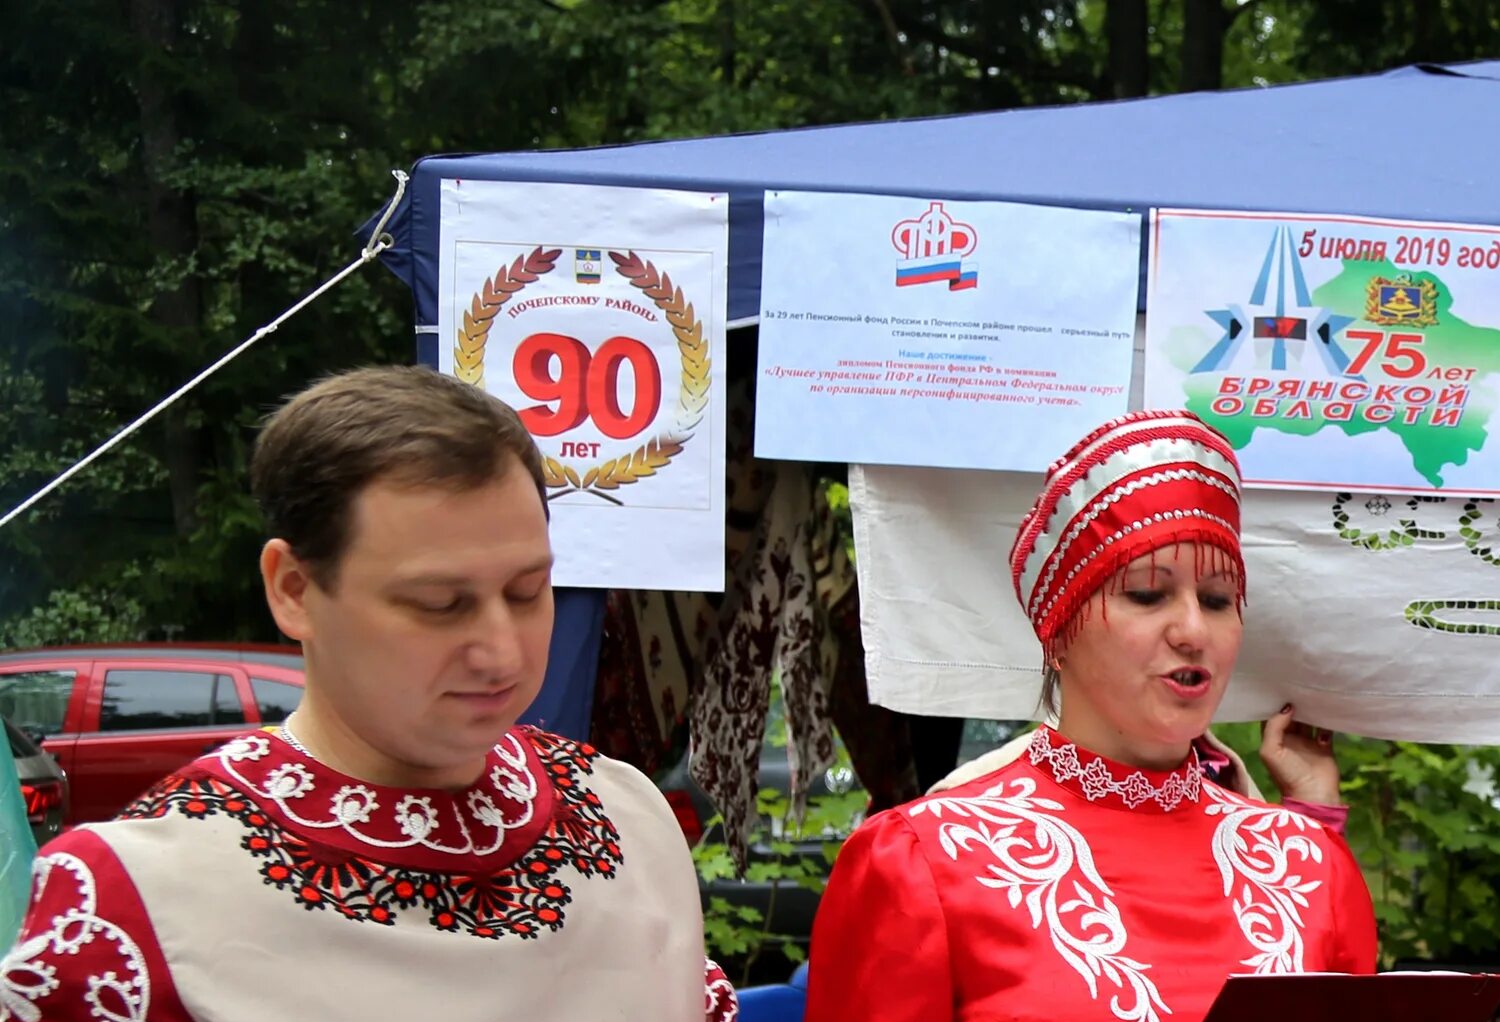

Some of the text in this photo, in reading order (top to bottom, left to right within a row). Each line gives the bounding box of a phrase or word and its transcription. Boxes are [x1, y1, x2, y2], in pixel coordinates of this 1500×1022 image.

[1299, 229, 1316, 258] 5
[1318, 236, 1387, 263] июля
[1395, 235, 1450, 267] 2019
[507, 296, 658, 322] ПОЧЕПСКОМУ РАЙОНУ
[806, 312, 862, 323] Пенсионный
[864, 315, 888, 325] фонд
[891, 317, 921, 326] России
[931, 318, 980, 329] Почепском
[982, 321, 1015, 331] районе
[1017, 324, 1052, 334] прошел
[1061, 327, 1109, 338] серьезный
[892, 329, 947, 340] становления
[837, 359, 882, 368] дипломом
[885, 360, 945, 371] Пенсионного
[948, 364, 976, 374] фонда
[979, 365, 993, 374] РФ
[898, 349, 924, 359] Наше
[927, 351, 987, 362] достижение
[1344, 330, 1477, 382] 75 лет
[513, 332, 661, 440] 90
[765, 366, 815, 379] «Лучшее
[817, 370, 881, 382] управление
[884, 371, 914, 383] ПФР
[926, 373, 1007, 389] Центральном
[1011, 378, 1087, 394] Федеральном
[1218, 376, 1470, 409] БРЯНСКОЙ
[810, 384, 824, 392] по
[826, 385, 896, 397] организации
[899, 386, 1035, 404] персонифицированного
[1211, 397, 1467, 428] ОБЛАСТИ
[559, 440, 600, 459] лет
